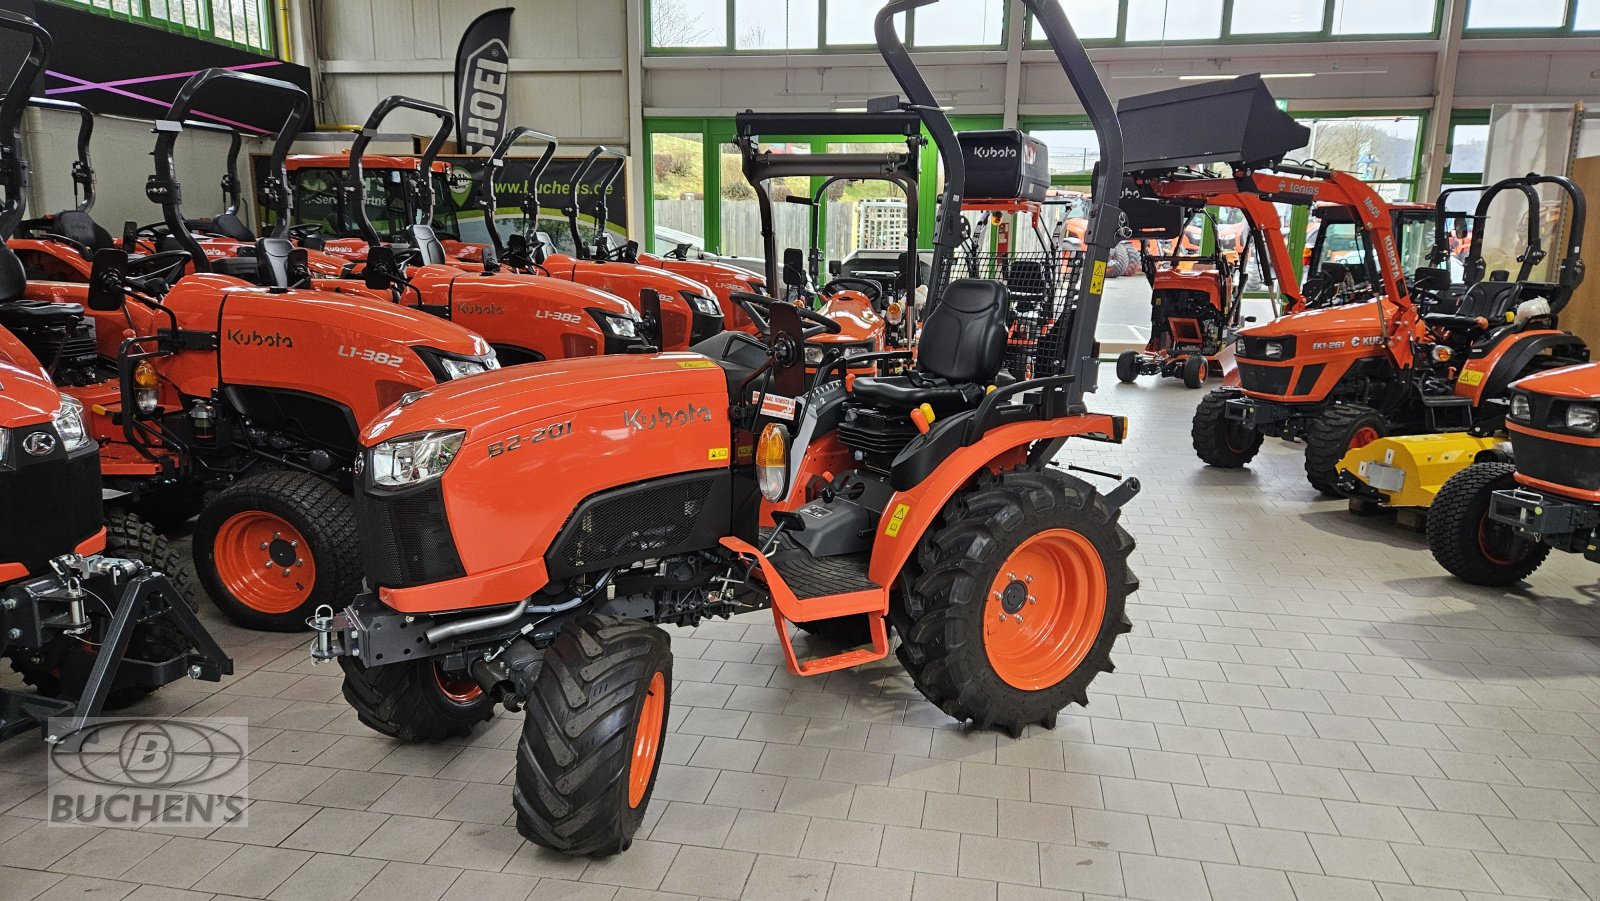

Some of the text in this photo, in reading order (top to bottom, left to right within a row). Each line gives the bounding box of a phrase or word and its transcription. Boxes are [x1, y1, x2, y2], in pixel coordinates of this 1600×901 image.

[974, 146, 1017, 158] Kubota
[1290, 182, 1320, 196] tenias
[1384, 235, 1400, 279] KUBOTA
[457, 303, 582, 324] Kubota L1-382
[227, 329, 404, 368] Kubota L1-382
[1312, 341, 1346, 350] EK1-261
[487, 402, 712, 459] B2-201 Kubota
